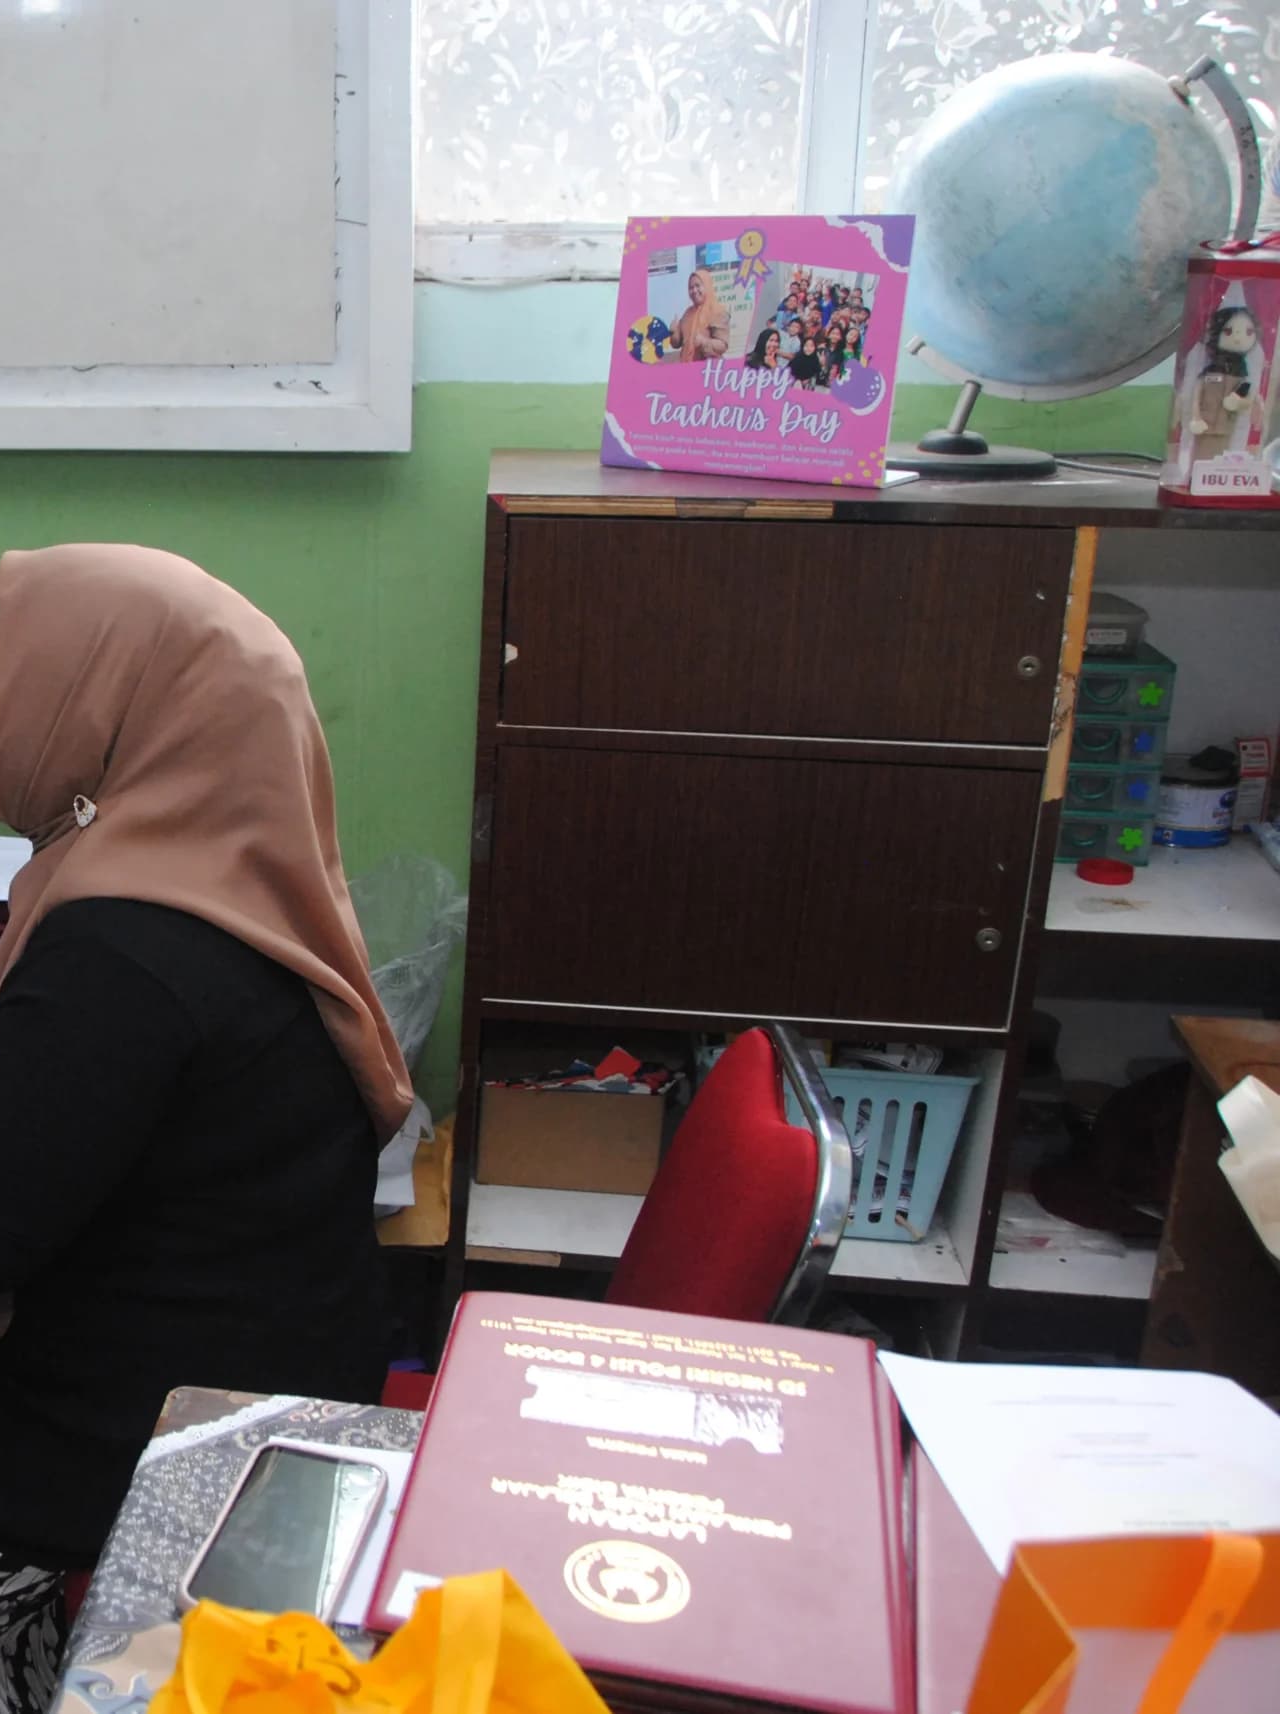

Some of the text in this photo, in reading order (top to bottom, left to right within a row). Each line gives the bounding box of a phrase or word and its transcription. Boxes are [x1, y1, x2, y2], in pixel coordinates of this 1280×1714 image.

[702, 357, 793, 400] Happy
[645, 392, 841, 444] Teacher's Day
[1202, 474, 1259, 487] IBU EVA
[504, 1342, 585, 1366] BOGOR
[590, 1354, 606, 1368] 4
[568, 1502, 707, 1544] LAPORAN
